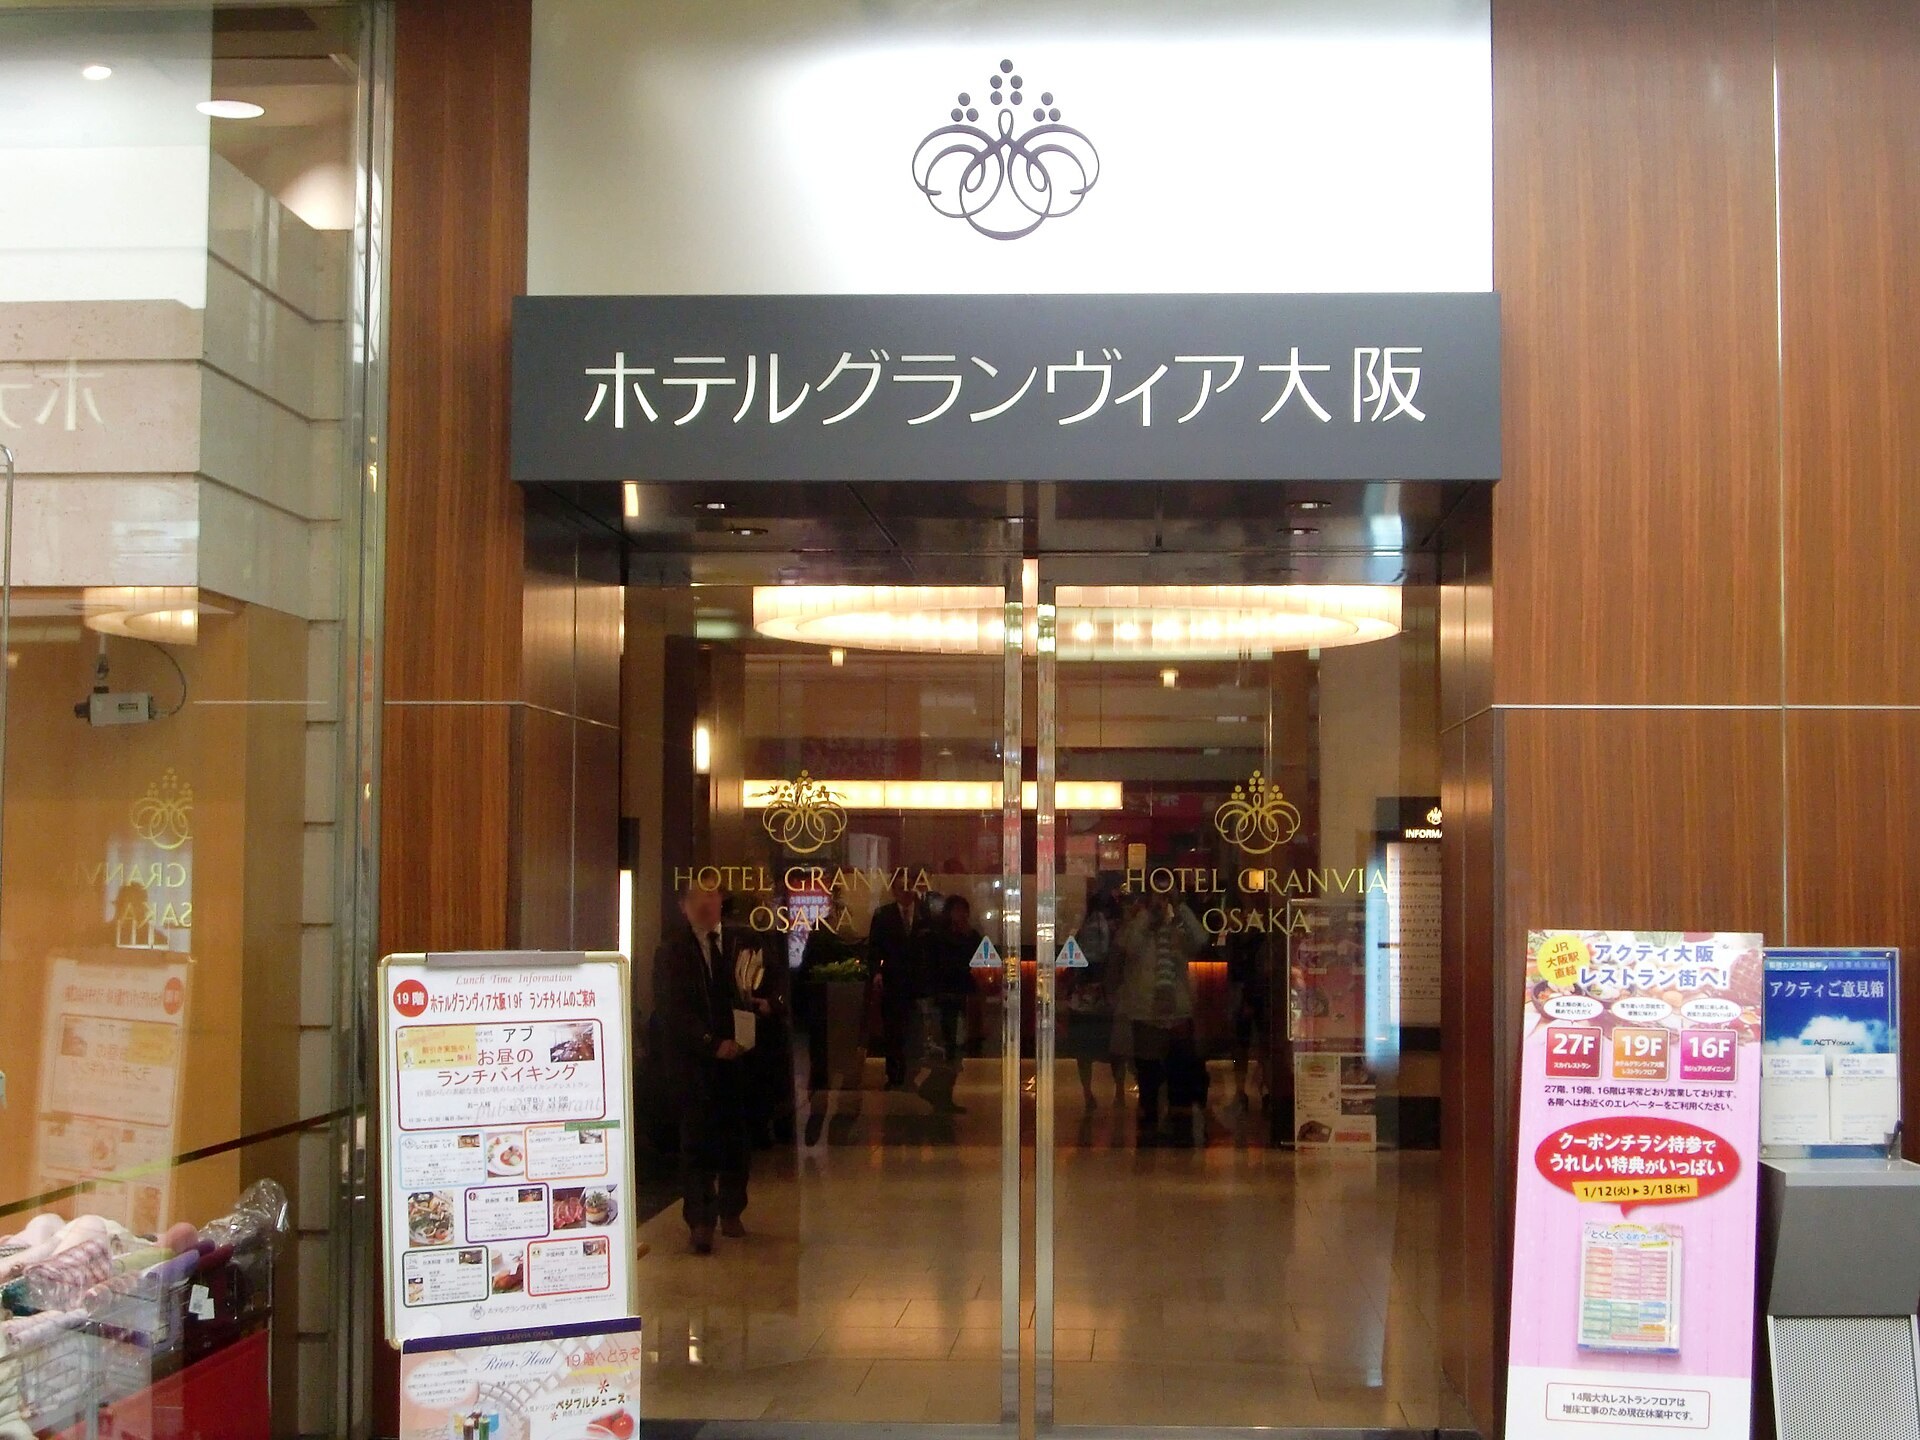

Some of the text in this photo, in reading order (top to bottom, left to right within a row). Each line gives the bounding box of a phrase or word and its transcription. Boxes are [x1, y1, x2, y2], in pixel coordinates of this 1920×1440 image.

[583, 346, 1428, 429] ホテルグランヴィア大阪
[673, 866, 933, 894] HOTEL GRANVIA
[1125, 867, 1389, 895] HOTEL GRANVIA
[750, 905, 857, 935] OSAKA
[1202, 907, 1311, 935] OSAKA
[1552, 941, 1569, 954] JR
[1594, 944, 1714, 963] アクティ大阪
[1546, 951, 1580, 969] 大阪駅
[455, 971, 573, 986] Lunch Time Information
[1554, 965, 1578, 980] 直結
[396, 991, 425, 1006] 19階
[529, 988, 596, 1010] ランチタイムのご案内
[1769, 980, 1885, 998] アクティご意見箱
[1552, 1032, 1595, 1056] 27F
[1621, 1034, 1663, 1057] 19F
[1688, 1036, 1732, 1059] 16F
[477, 1048, 534, 1067] お昼の
[437, 1062, 578, 1087] ランチバイキング
[1559, 1132, 1717, 1155] クーポンチラシ持参で
[1549, 1153, 1725, 1177] うれしい特典がいっぱい
[1583, 1184, 1690, 1198] 1/12(火) 3/18(木)
[481, 1352, 516, 1372] River
[1570, 1391, 1686, 1408] 14階大丸レストランフロアは
